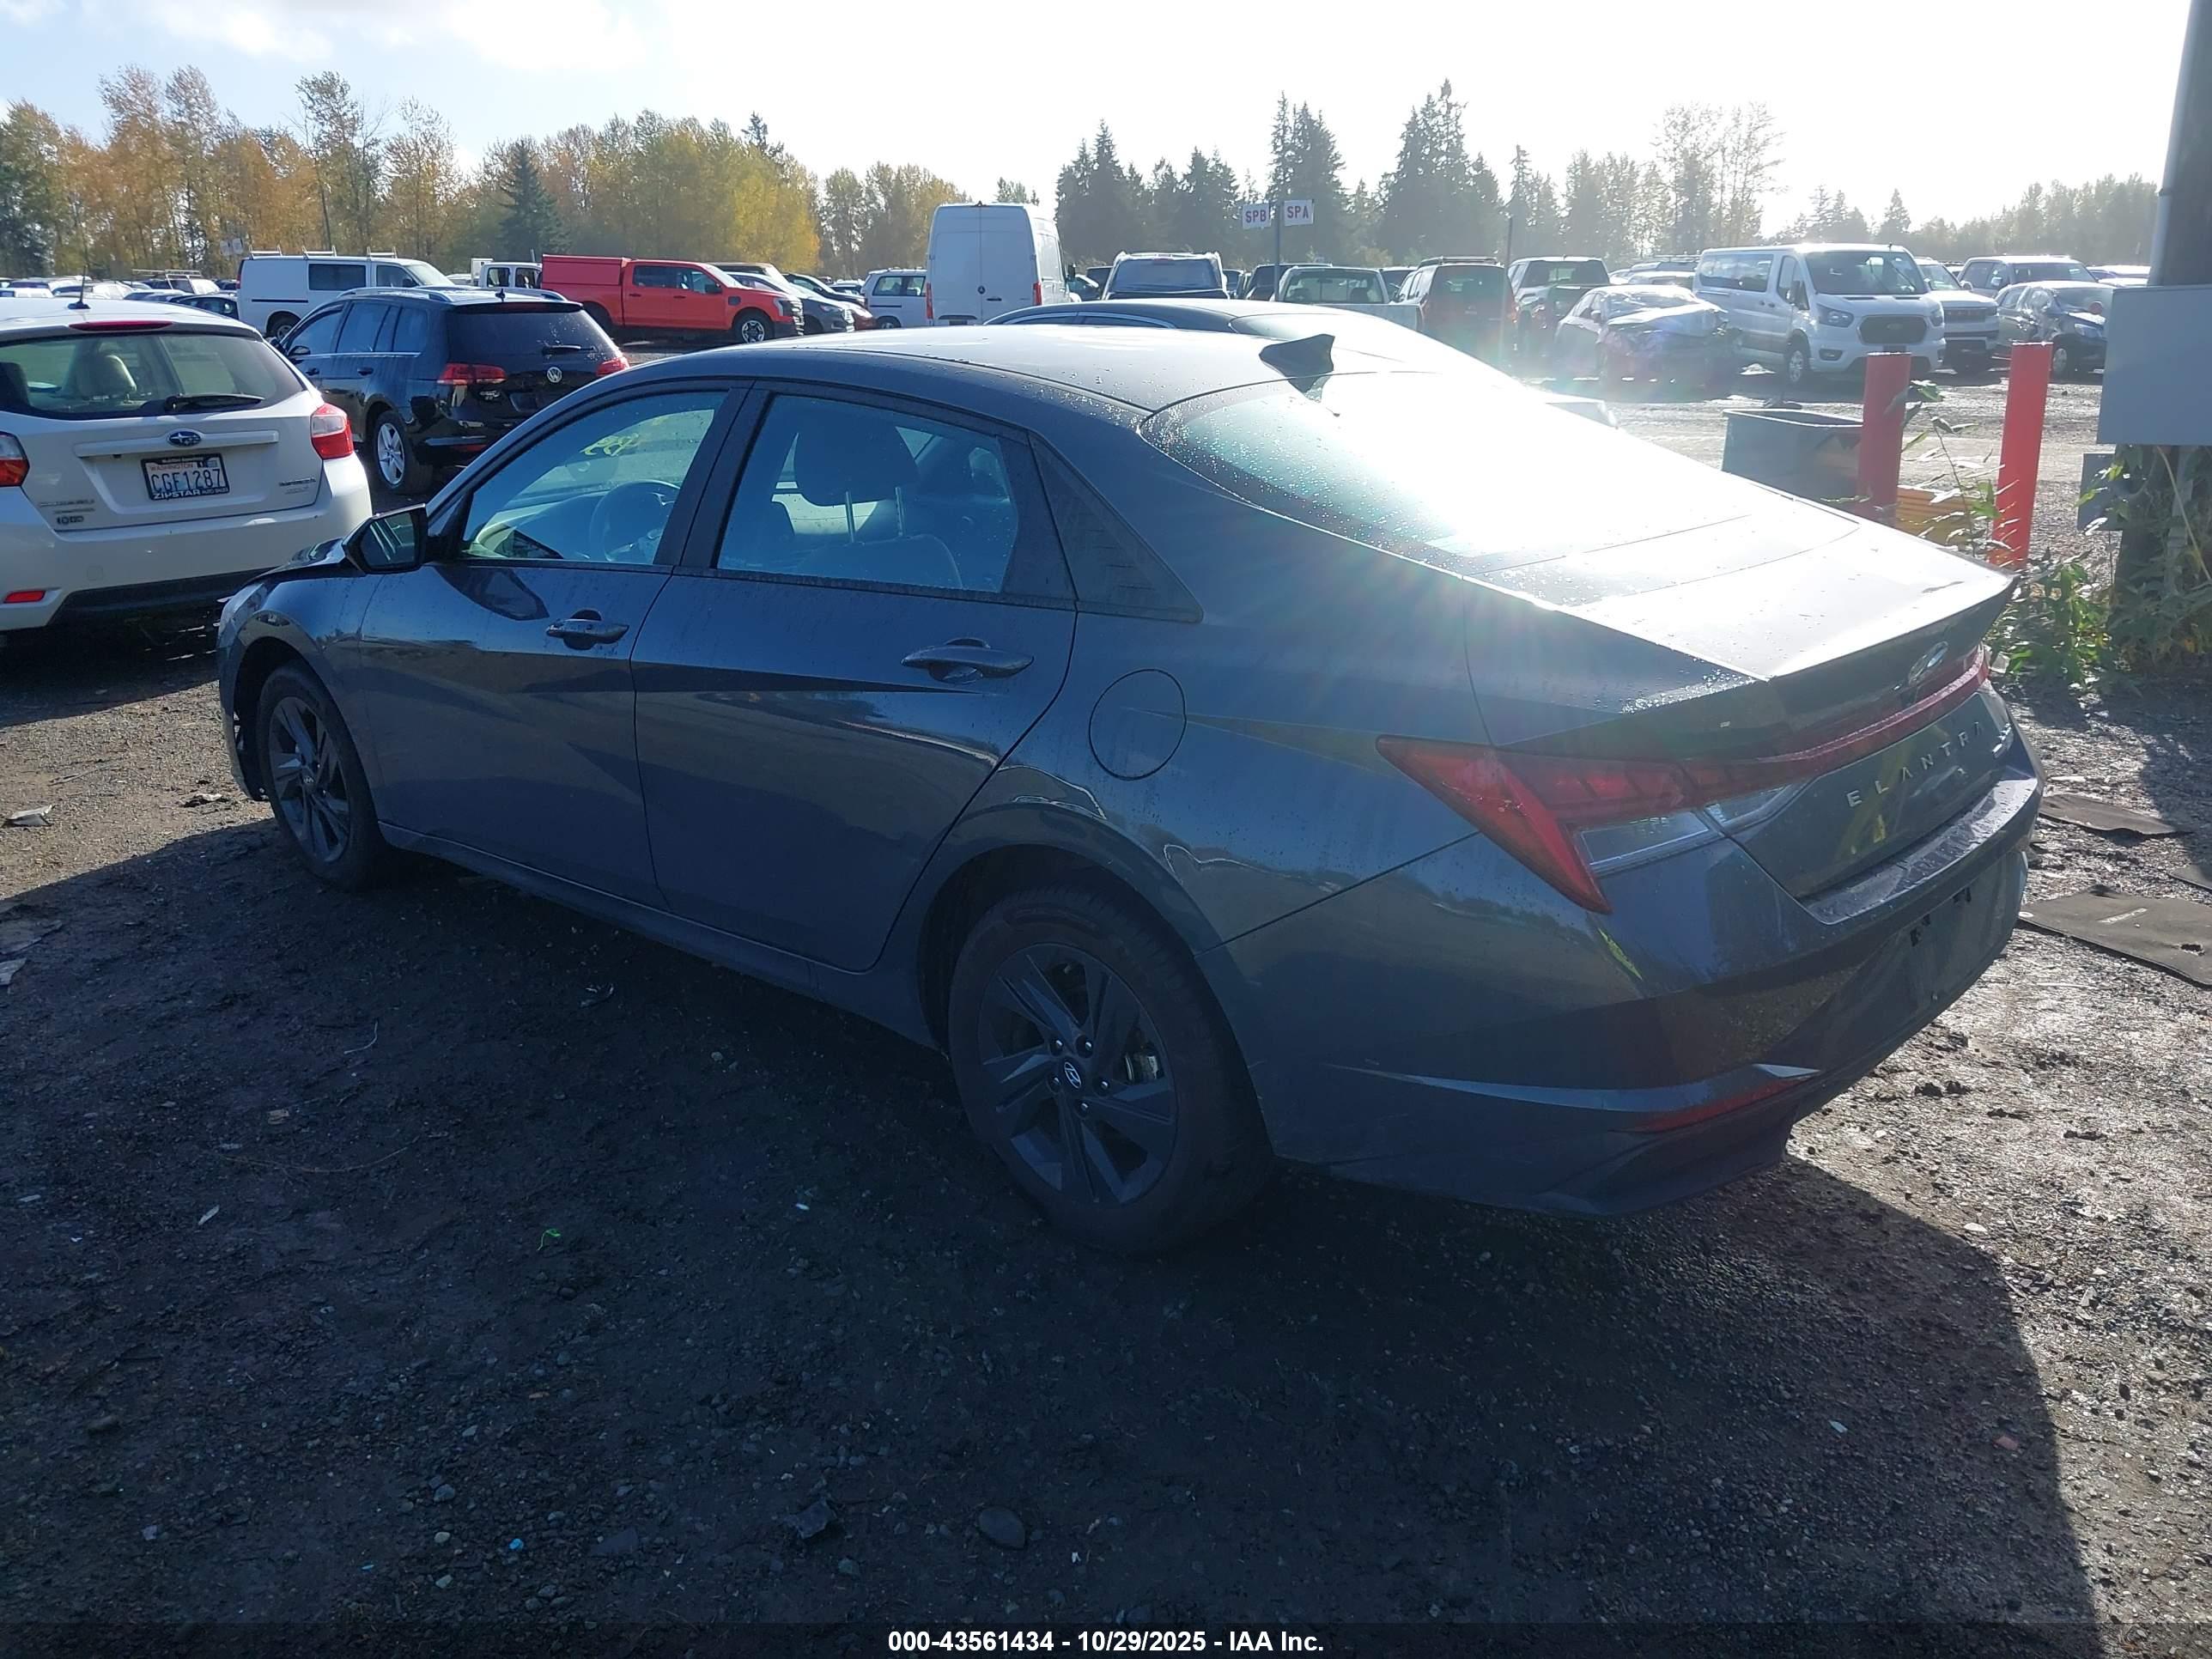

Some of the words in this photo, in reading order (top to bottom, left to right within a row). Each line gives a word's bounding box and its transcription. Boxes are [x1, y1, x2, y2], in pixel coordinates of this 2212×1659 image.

[1246, 210, 1267, 223] SPB
[1287, 205, 1309, 219] SPA
[1848, 723, 1983, 806] ELANTRA
